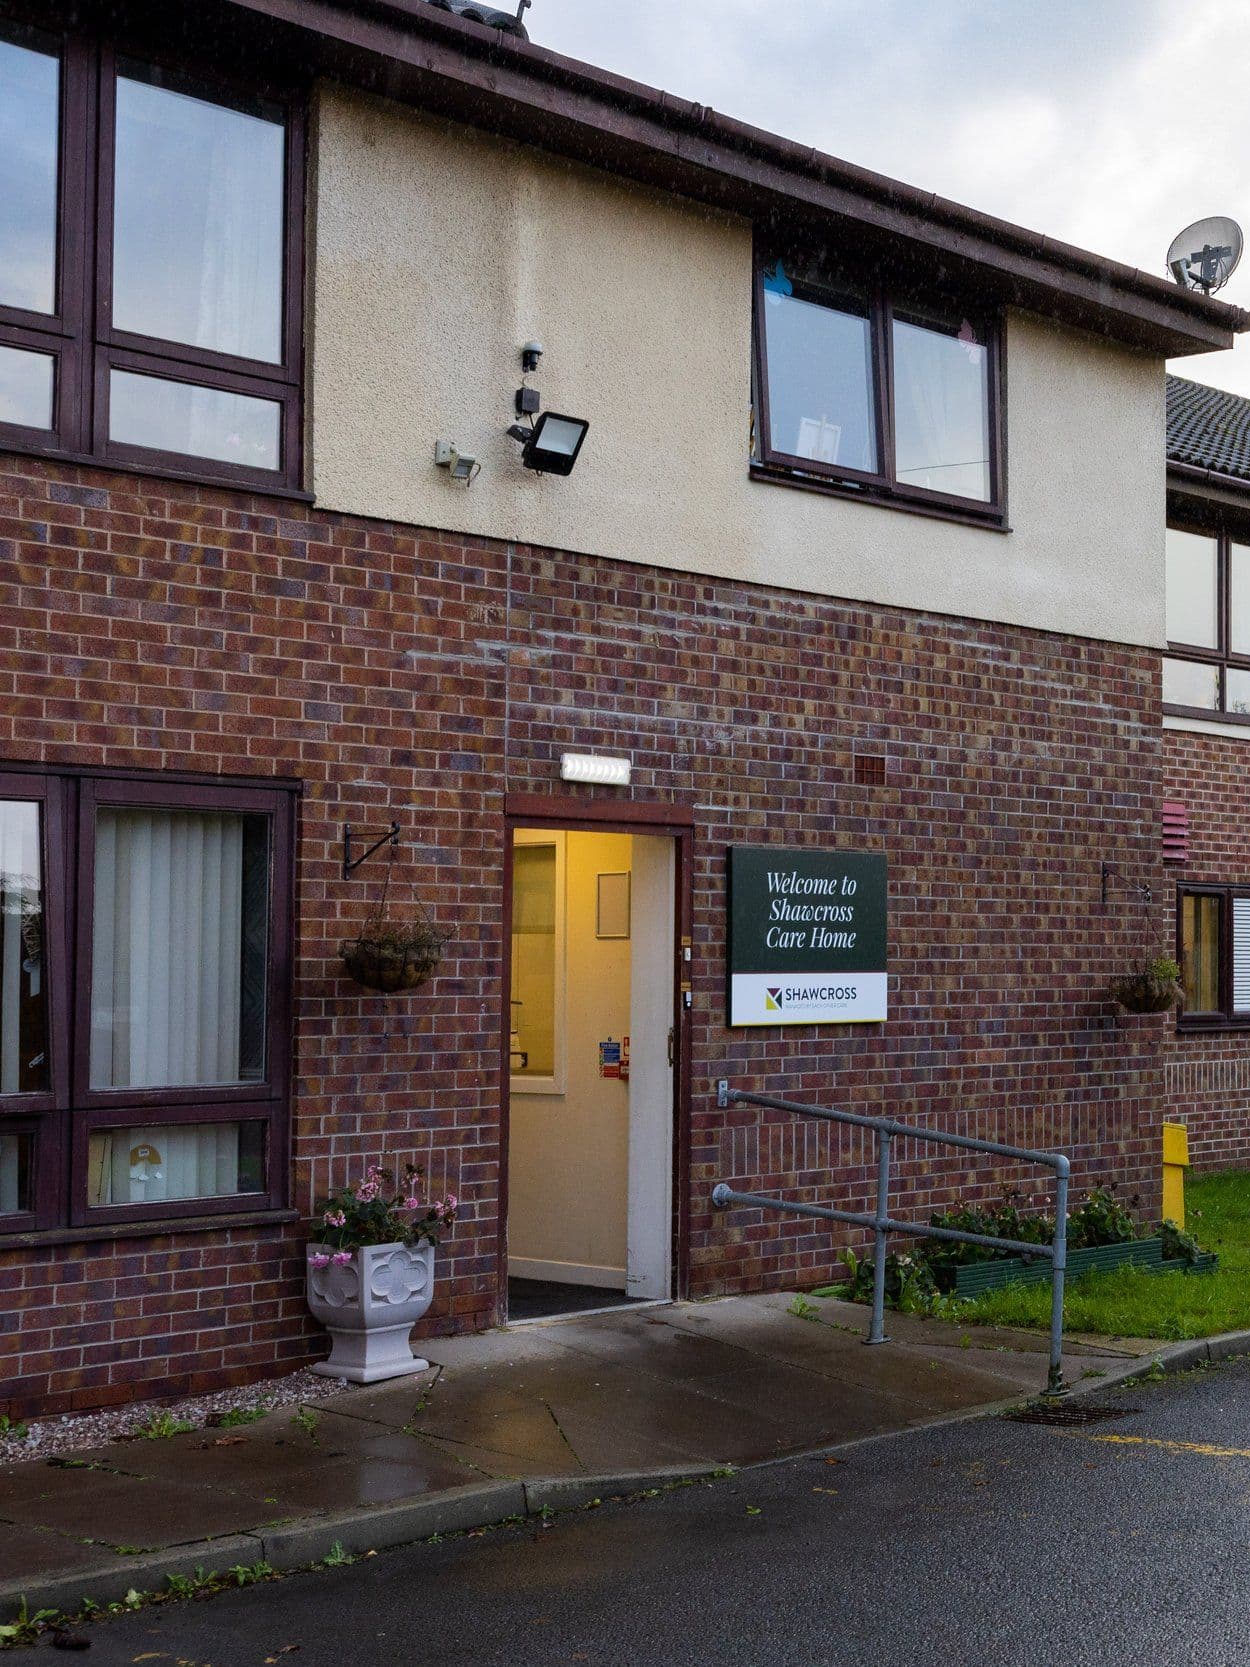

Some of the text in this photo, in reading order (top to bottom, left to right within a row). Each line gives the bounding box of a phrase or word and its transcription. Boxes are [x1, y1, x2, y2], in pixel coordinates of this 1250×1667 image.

[766, 871, 857, 896] Welcome to
[768, 898, 854, 922] Shawcross
[766, 926, 857, 948] Care Home
[785, 987, 857, 1001] SHAWCROSS
